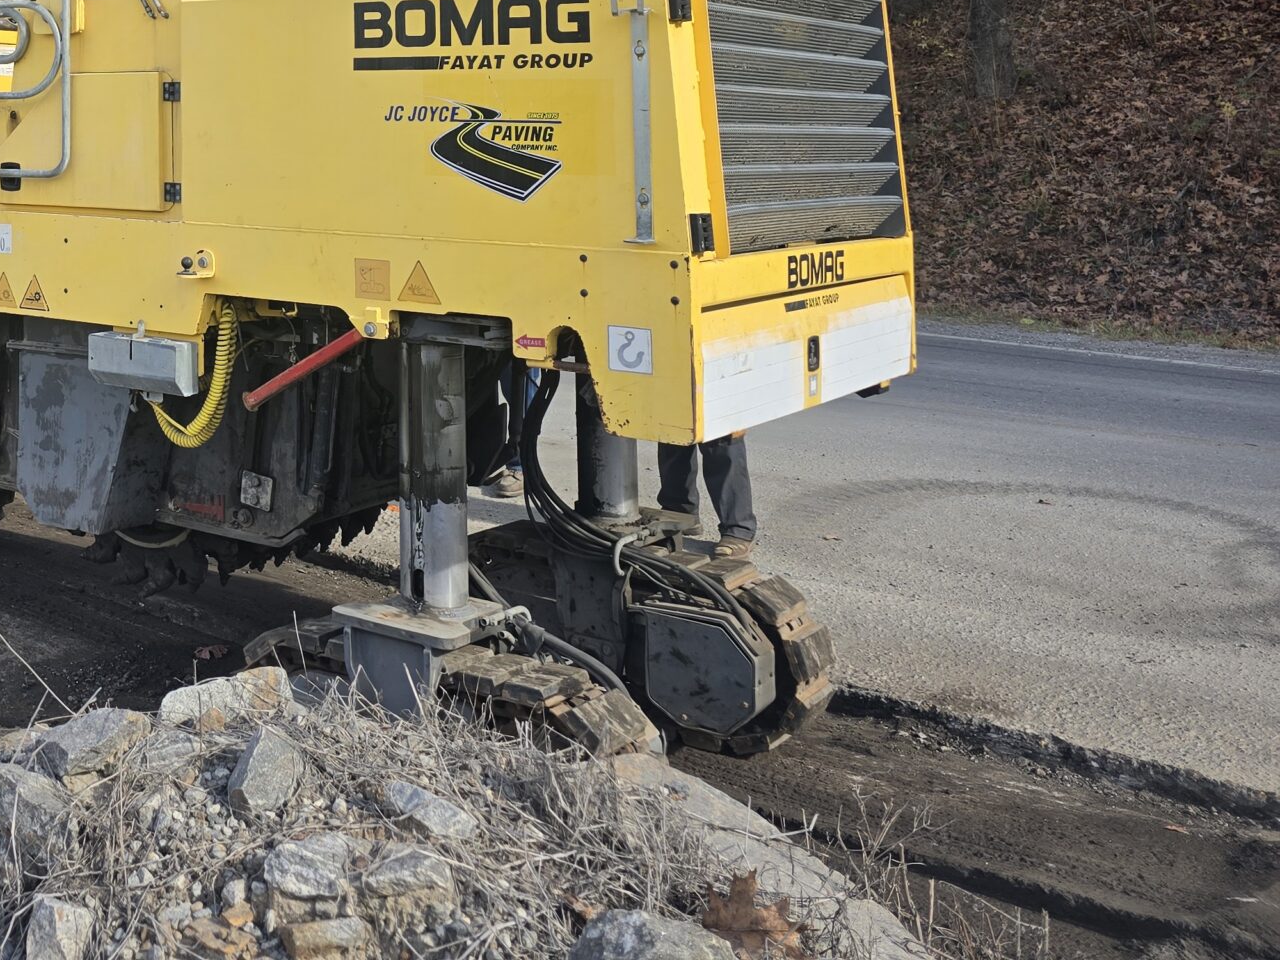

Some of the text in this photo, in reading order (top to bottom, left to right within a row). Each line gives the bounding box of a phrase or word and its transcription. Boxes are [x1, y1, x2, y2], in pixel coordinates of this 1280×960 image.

[438, 52, 593, 70] FAYAT GROUP
[384, 105, 461, 122] JC JOYCE
[491, 125, 554, 142] PAVING
[511, 143, 544, 151] COMPANY
[788, 250, 844, 289] BOMAG
[805, 293, 839, 308] FAYAT GROUP
